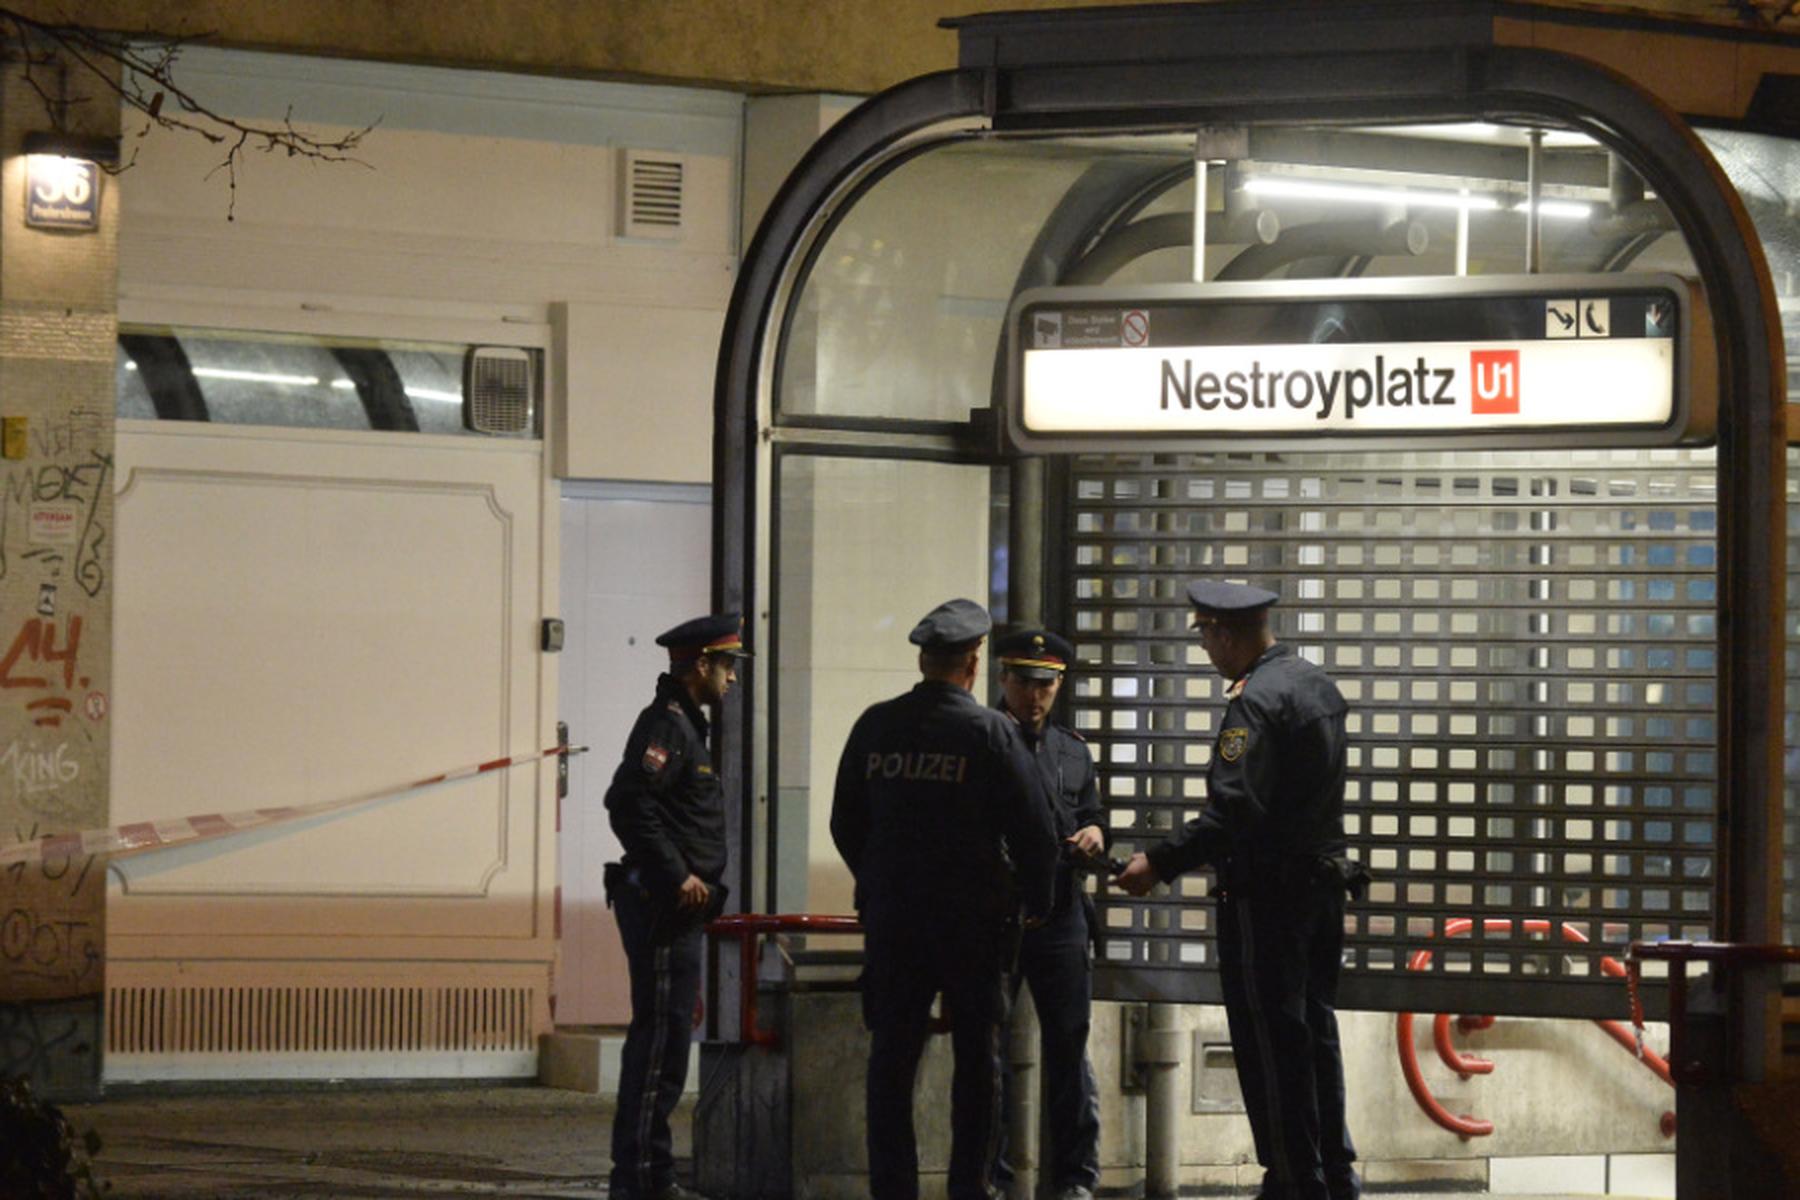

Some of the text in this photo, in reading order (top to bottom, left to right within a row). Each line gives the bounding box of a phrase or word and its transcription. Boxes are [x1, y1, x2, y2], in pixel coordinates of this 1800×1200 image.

[1160, 355, 1515, 420] Nestroyplatz U1
[866, 752, 968, 783] POLIZEI
